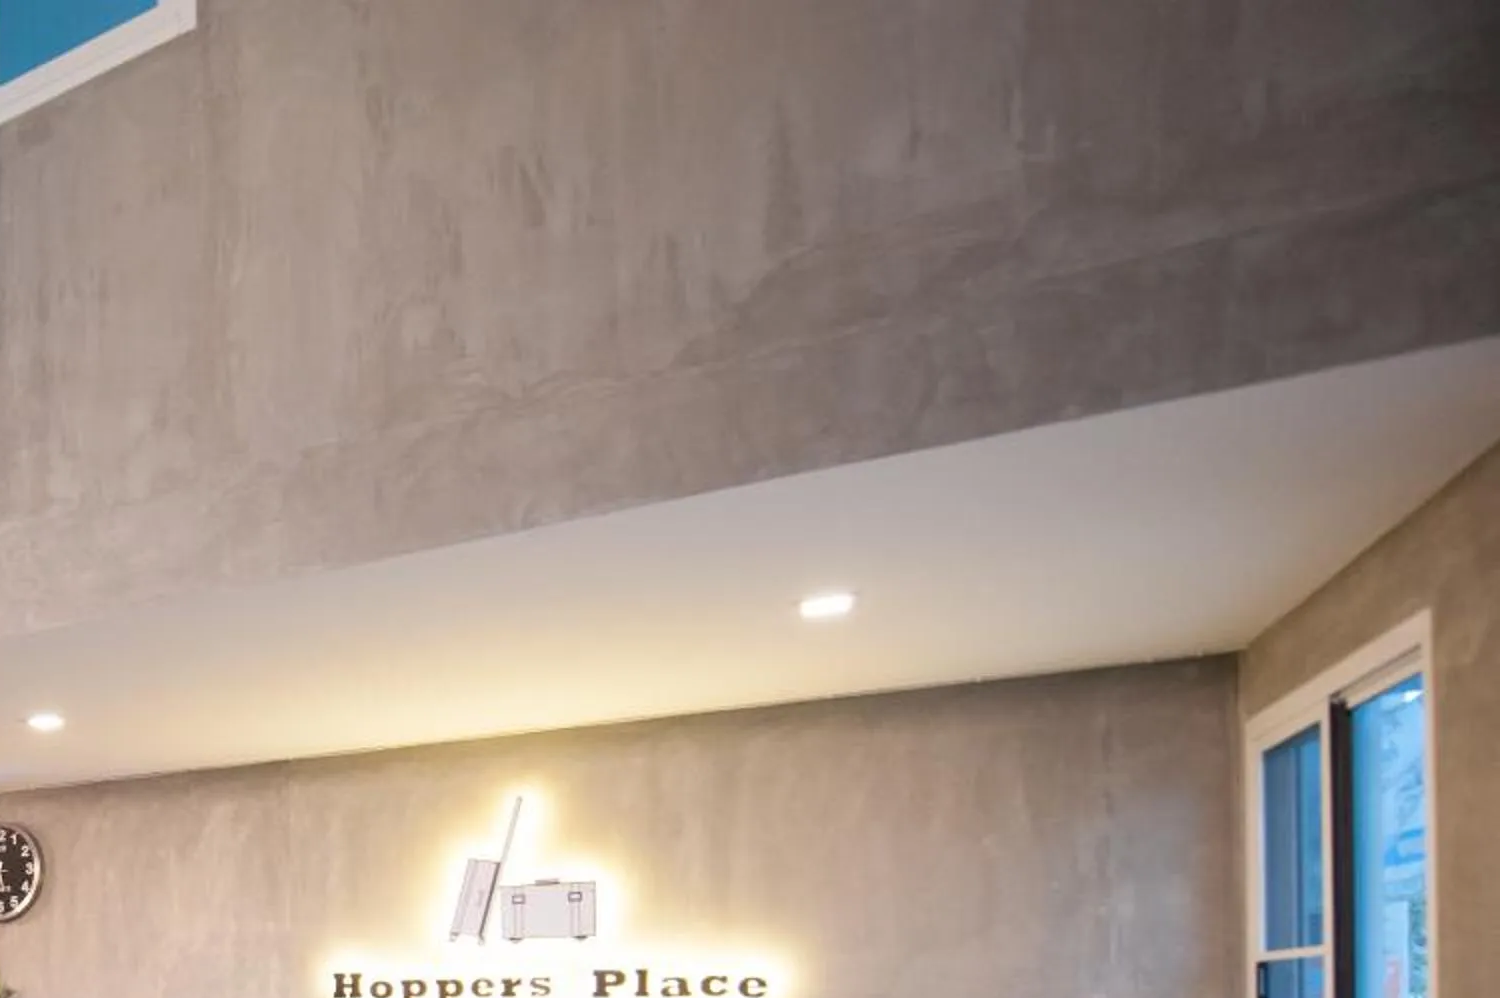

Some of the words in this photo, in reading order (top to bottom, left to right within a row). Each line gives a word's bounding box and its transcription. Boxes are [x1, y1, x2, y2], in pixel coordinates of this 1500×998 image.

[10, 833, 18, 845] 1
[21, 845, 31, 858] 2
[25, 861, 35, 875] 3
[21, 879, 31, 894] 4
[9, 895, 19, 909] 5
[592, 968, 768, 998] Place
